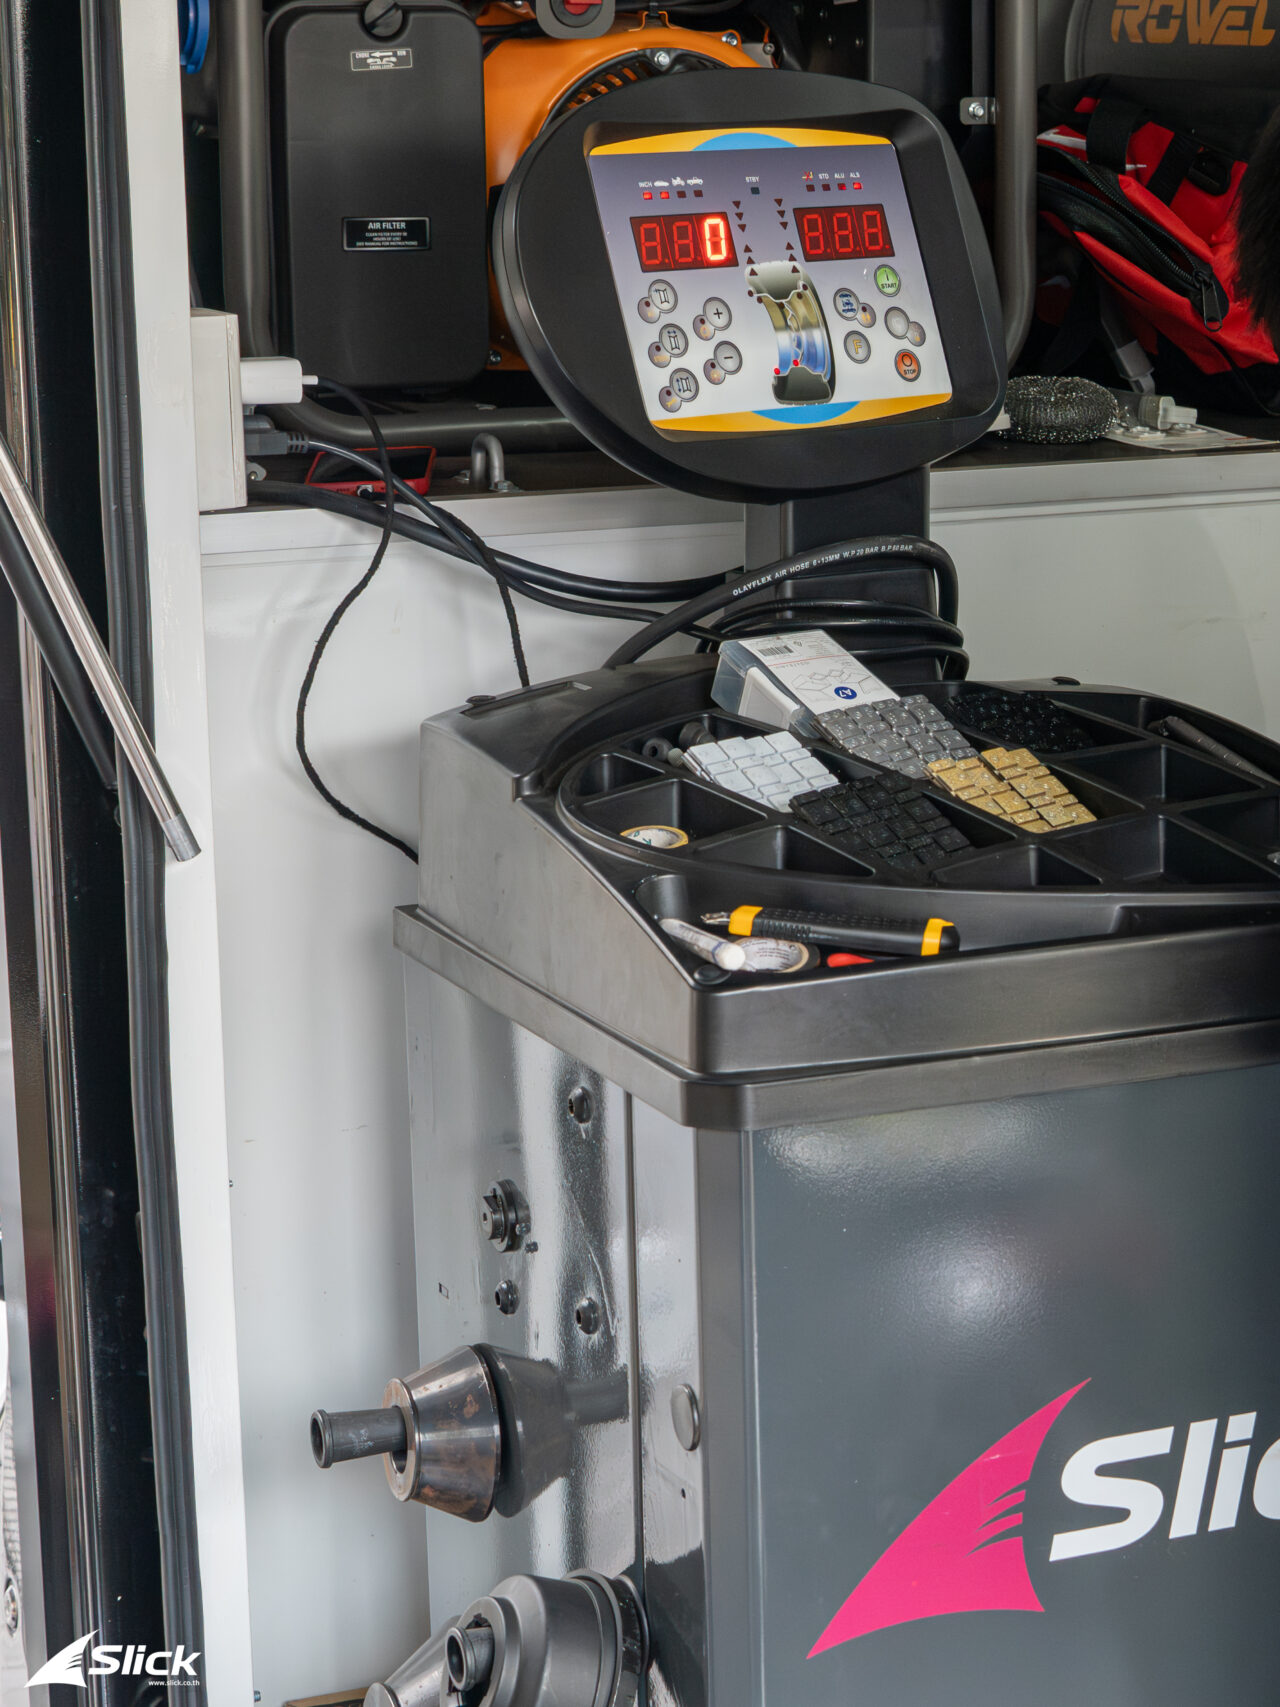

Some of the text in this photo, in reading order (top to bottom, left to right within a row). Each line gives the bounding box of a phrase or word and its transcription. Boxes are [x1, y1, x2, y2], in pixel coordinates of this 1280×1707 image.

[368, 222, 407, 230] AIR FILTER
[881, 282, 897, 290] START
[852, 339, 863, 355] F
[903, 368, 917, 376] STOP
[774, 569, 788, 579] AIR
[789, 561, 810, 574] HOSE
